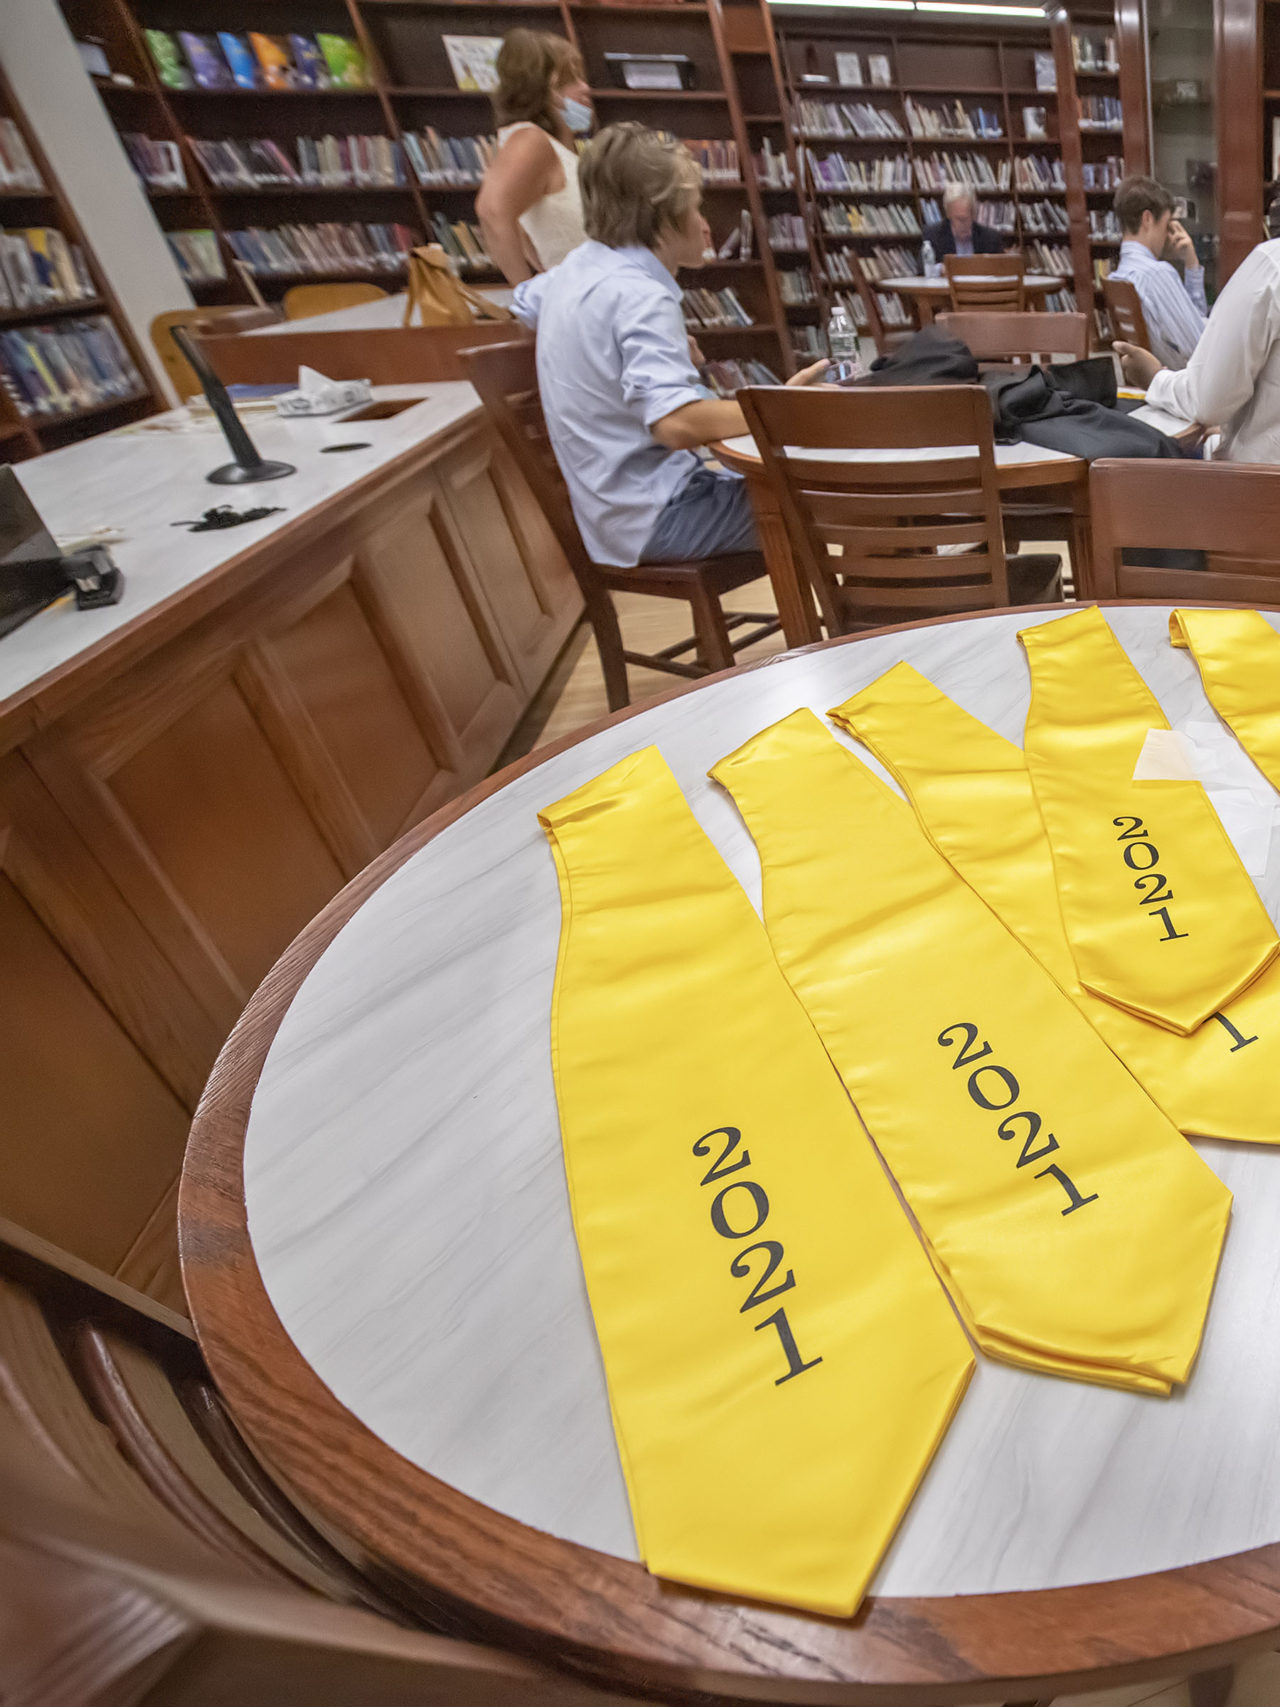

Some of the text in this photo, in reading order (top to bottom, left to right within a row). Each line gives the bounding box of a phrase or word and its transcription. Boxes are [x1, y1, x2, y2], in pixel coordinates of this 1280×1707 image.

[1112, 816, 1189, 942] 2021
[937, 1022, 1099, 1217] 2021
[692, 1126, 823, 1386] 2021
